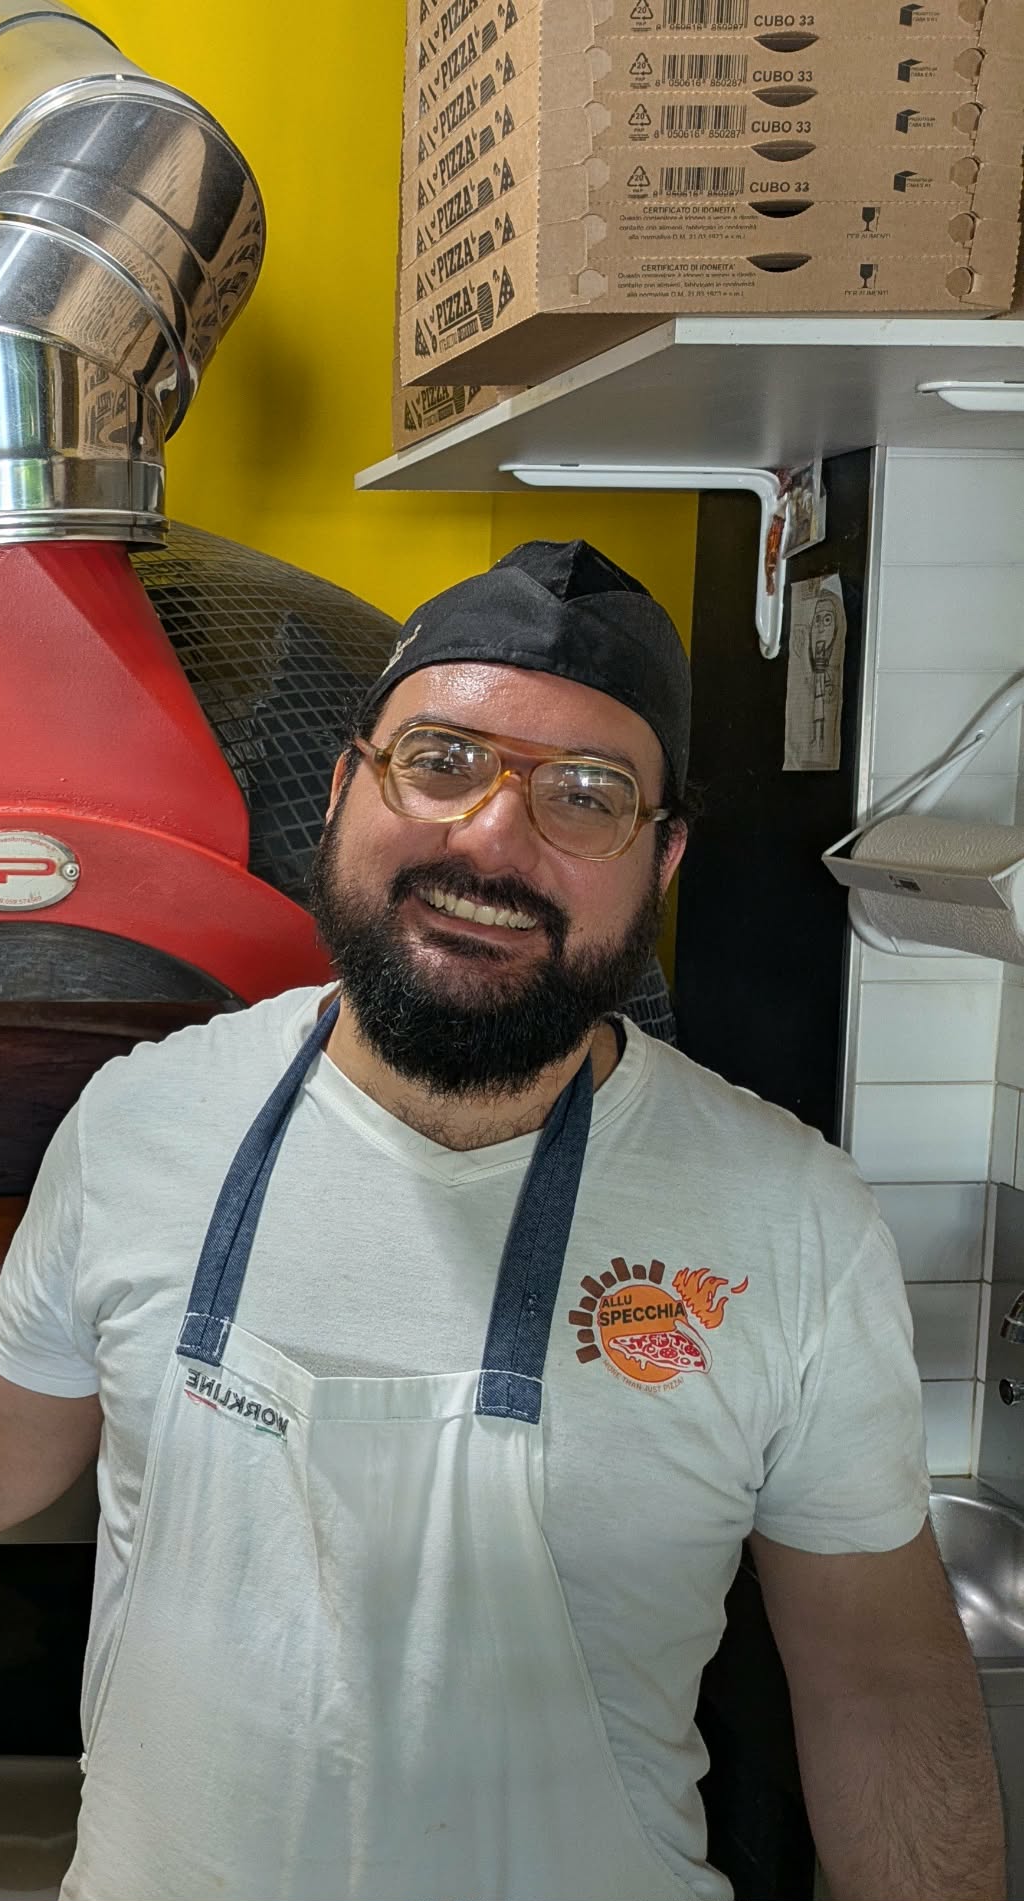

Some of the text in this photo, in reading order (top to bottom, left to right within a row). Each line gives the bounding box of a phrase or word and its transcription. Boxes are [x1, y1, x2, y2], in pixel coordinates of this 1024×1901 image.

[753, 15, 815, 27] CUBO 33
[441, 32, 477, 89] PIZZA
[752, 70, 813, 83] CUBO 33
[439, 84, 476, 139] PIZZA
[635, 112, 645, 120] 20
[751, 121, 811, 133] CUBO 33
[438, 134, 476, 186] PIZZA
[749, 181, 810, 193] CUBO 33
[437, 185, 474, 235] PIZZA
[643, 206, 691, 214] CERTIFICATO
[692, 206, 700, 214] DI
[436, 237, 474, 283] PIZZA
[435, 286, 473, 331] PIZZA
[421, 386, 449, 411] PIZZA
[599, 1302, 685, 1327] SPECCHIA
[602, 1295, 632, 1309] ALLU
[603, 1359, 621, 1379] MORE
[622, 1376, 642, 1391] THAN
[643, 1385, 661, 1393] JUST
